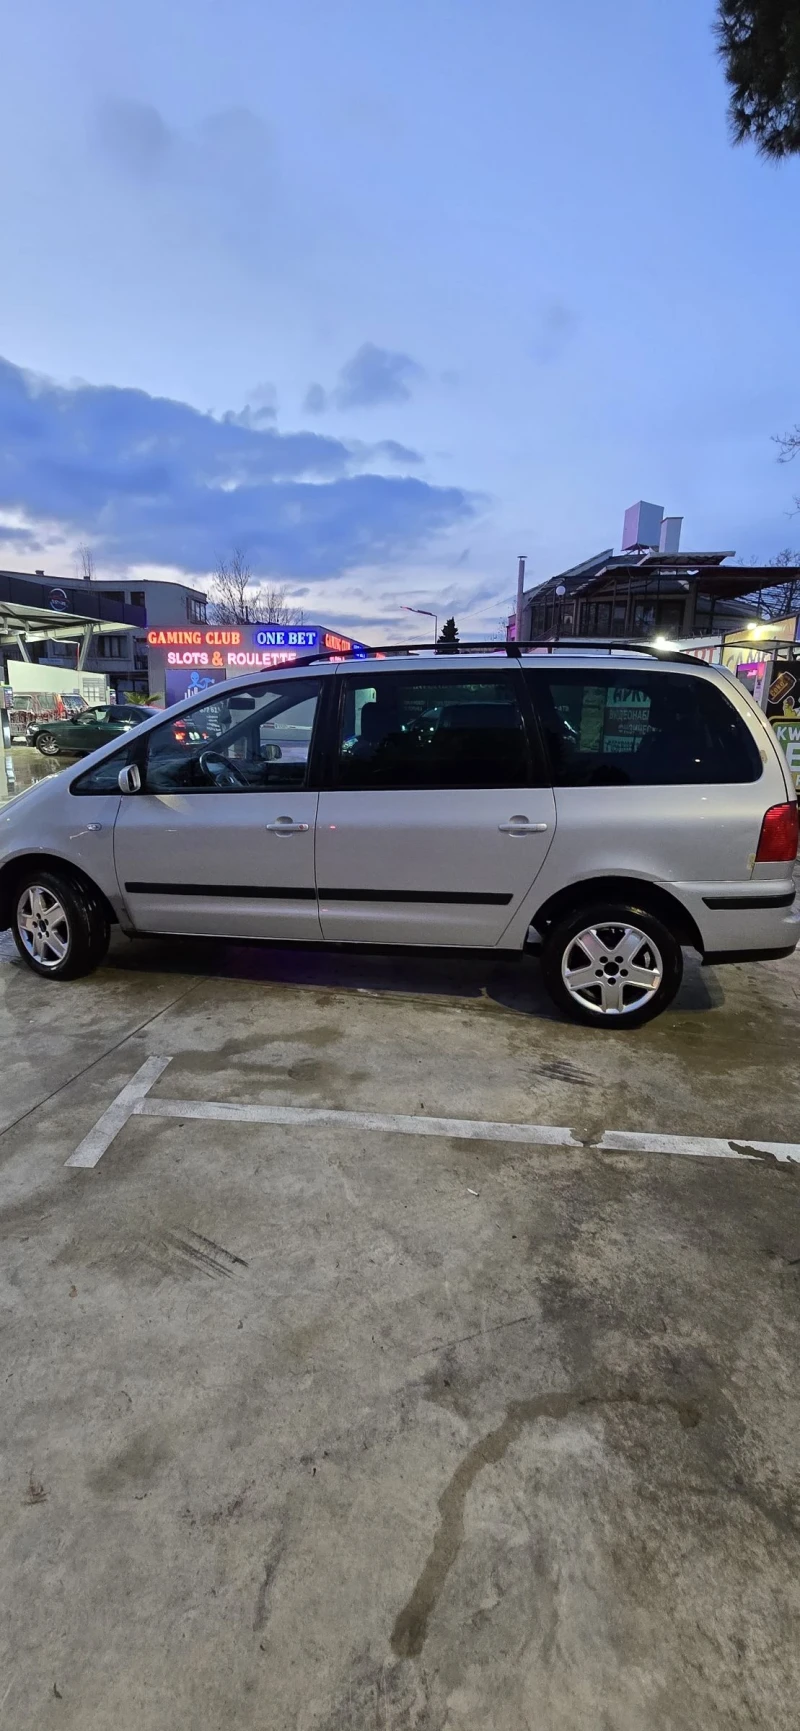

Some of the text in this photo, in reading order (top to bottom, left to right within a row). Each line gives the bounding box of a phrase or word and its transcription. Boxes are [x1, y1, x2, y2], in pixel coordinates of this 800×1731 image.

[148, 631, 240, 645] GAMING CLUB
[257, 631, 316, 645] ONE BET
[168, 652, 209, 665] SLOTS
[212, 651, 223, 666] &
